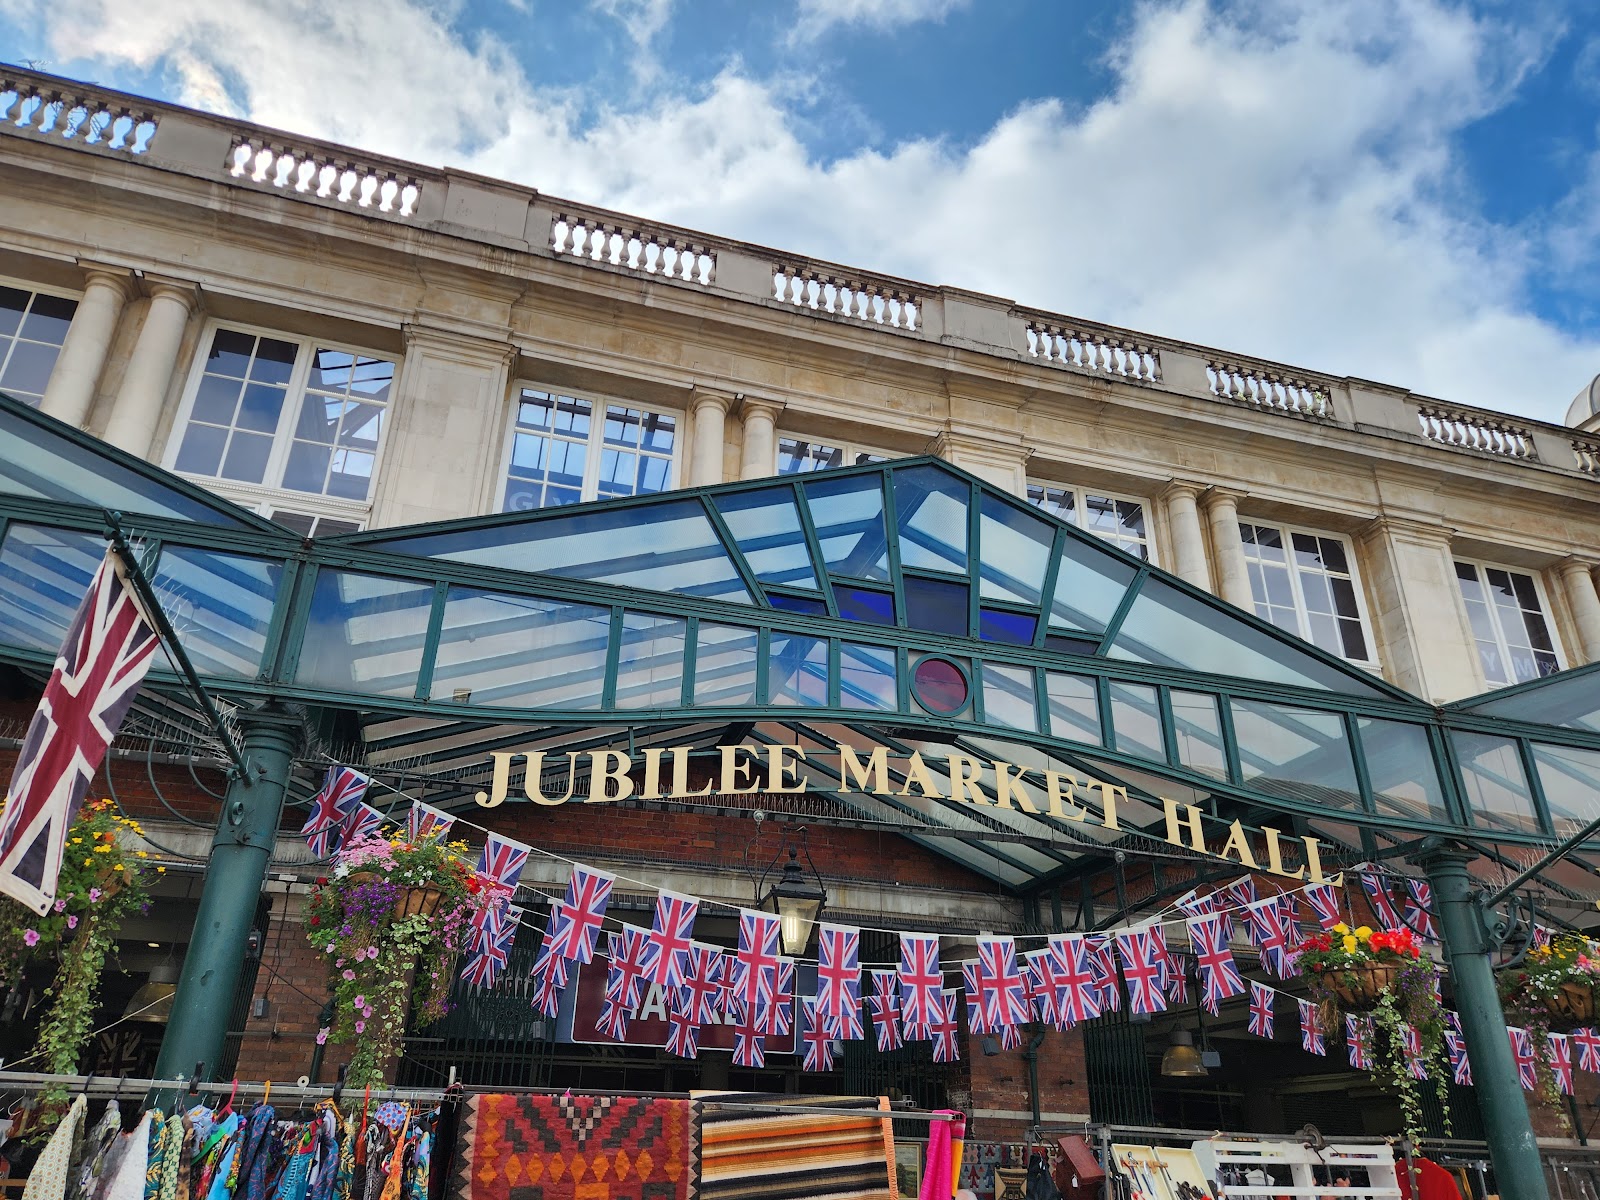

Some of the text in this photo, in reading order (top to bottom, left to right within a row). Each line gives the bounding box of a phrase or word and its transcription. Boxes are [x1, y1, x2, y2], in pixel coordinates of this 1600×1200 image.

[475, 744, 1344, 888] JUBILEE MARKET HALL
